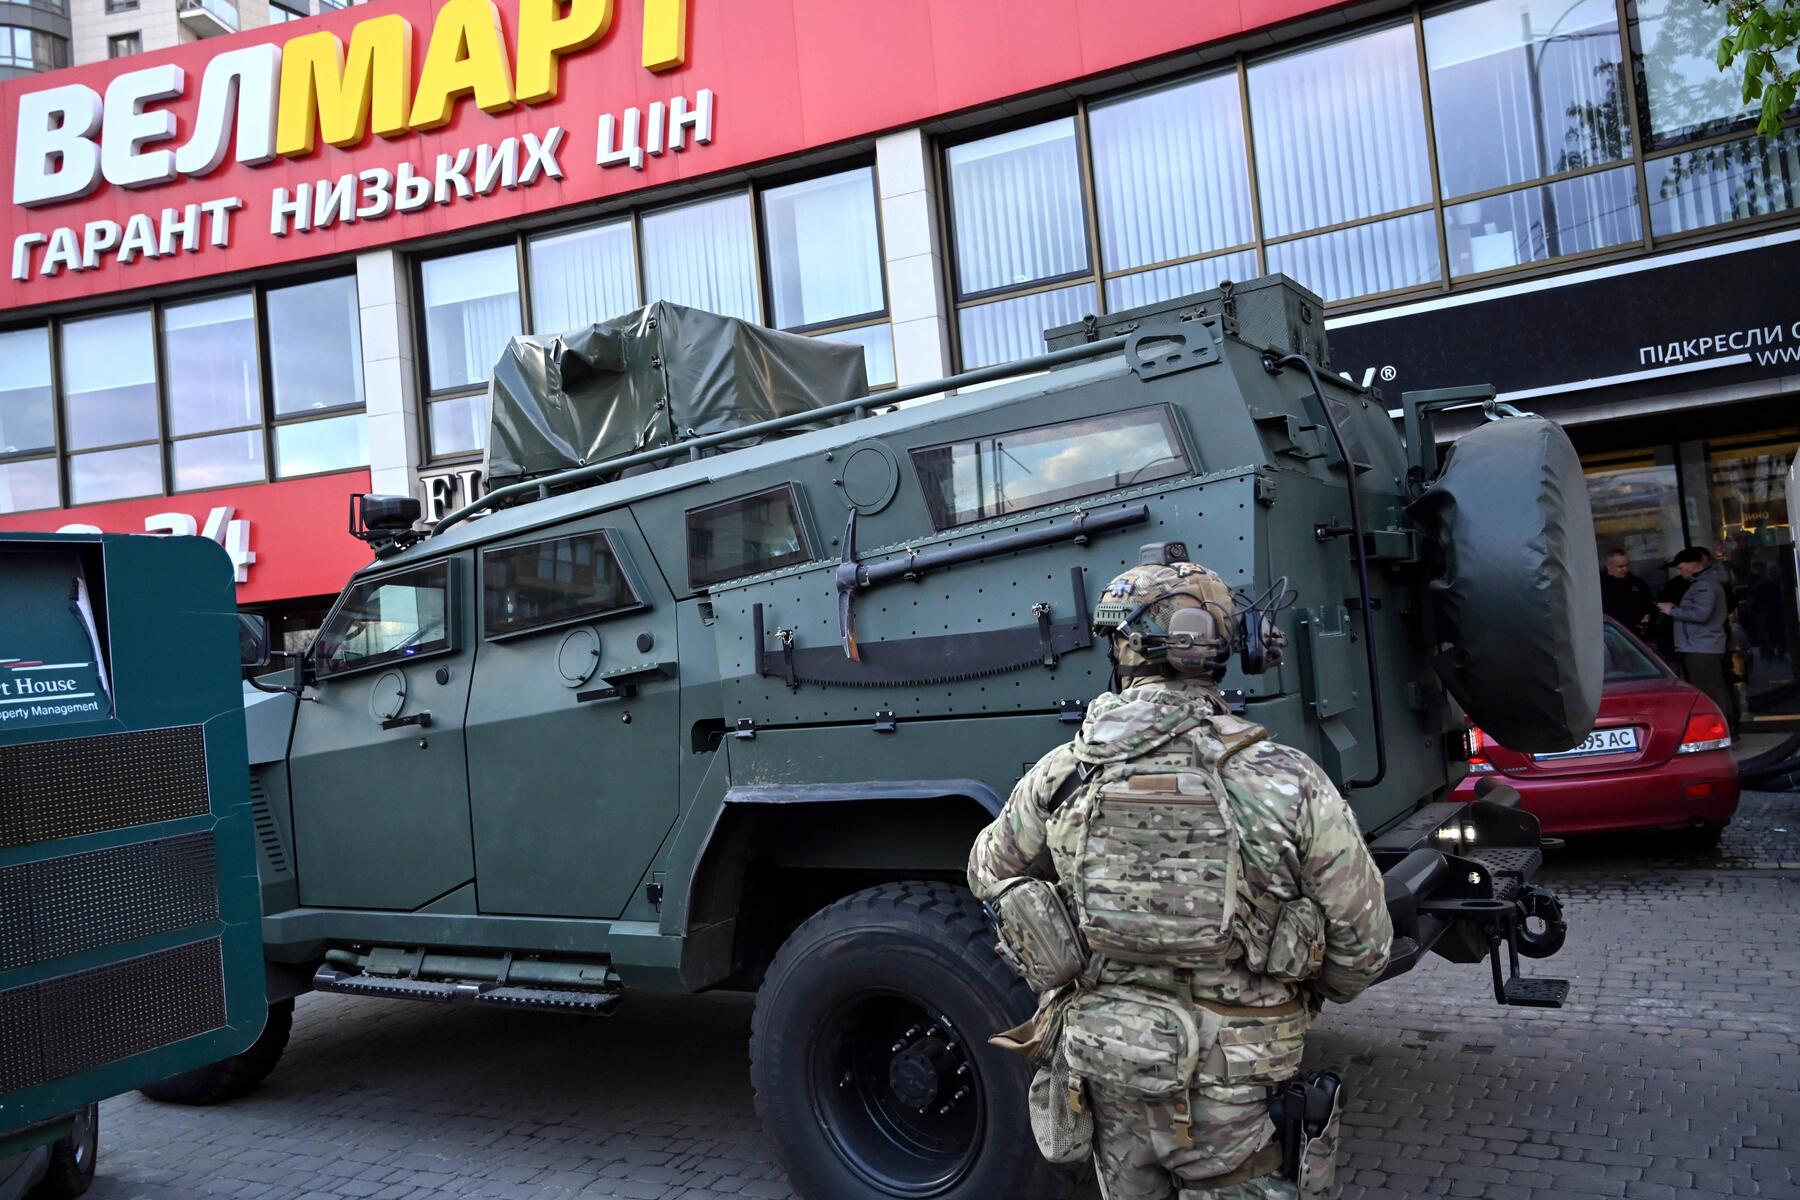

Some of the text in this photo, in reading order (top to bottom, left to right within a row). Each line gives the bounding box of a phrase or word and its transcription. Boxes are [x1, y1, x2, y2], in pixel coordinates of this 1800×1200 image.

[12, 88, 714, 281] ГАРАНТ НИЗЬКИХ ЦІН
[1639, 325, 1783, 364] ПІДКРЕСЛИ
[14, 677, 78, 695] House
[0, 701, 99, 720] perty Management
[1609, 731, 1631, 747] AC
